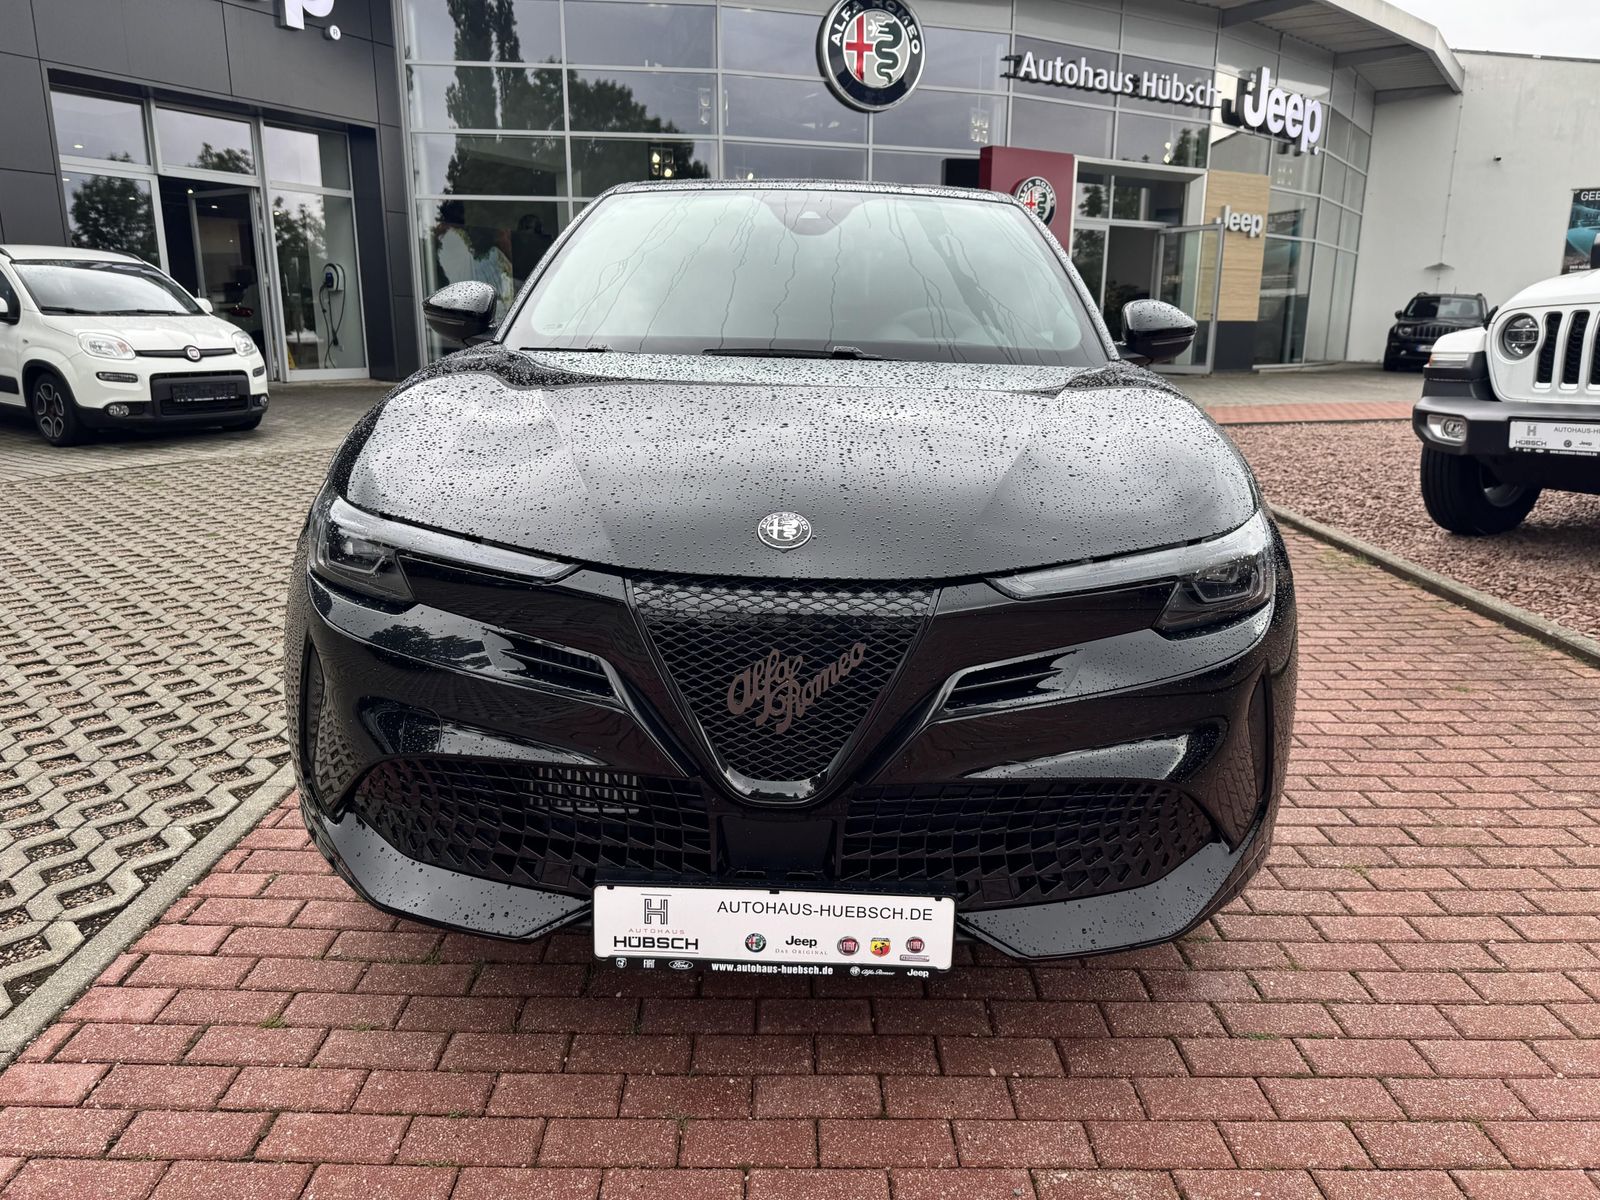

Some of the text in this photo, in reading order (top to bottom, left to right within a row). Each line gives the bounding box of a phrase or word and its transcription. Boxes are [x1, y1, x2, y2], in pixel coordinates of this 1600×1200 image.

[831, 0, 921, 54] ALFA ROMEO
[1019, 51, 1219, 107] Autohaus Hübsch
[1243, 66, 1322, 153] Jeep
[1216, 205, 1264, 238] Jeep
[762, 513, 808, 531] ALFA ROMEO
[727, 642, 866, 735] Alfa Romeo
[717, 900, 933, 921] AUTOHAUS-HUEBSCH.DE
[613, 935, 699, 950] HÜBSCH
[785, 935, 818, 948] Jeep
[843, 942, 857, 951] FIAT
[643, 959, 656, 969] FIAT
[671, 960, 690, 969] Ford
[711, 962, 834, 975] www.autohaus-huebsch.de
[906, 968, 930, 978] Jeep
